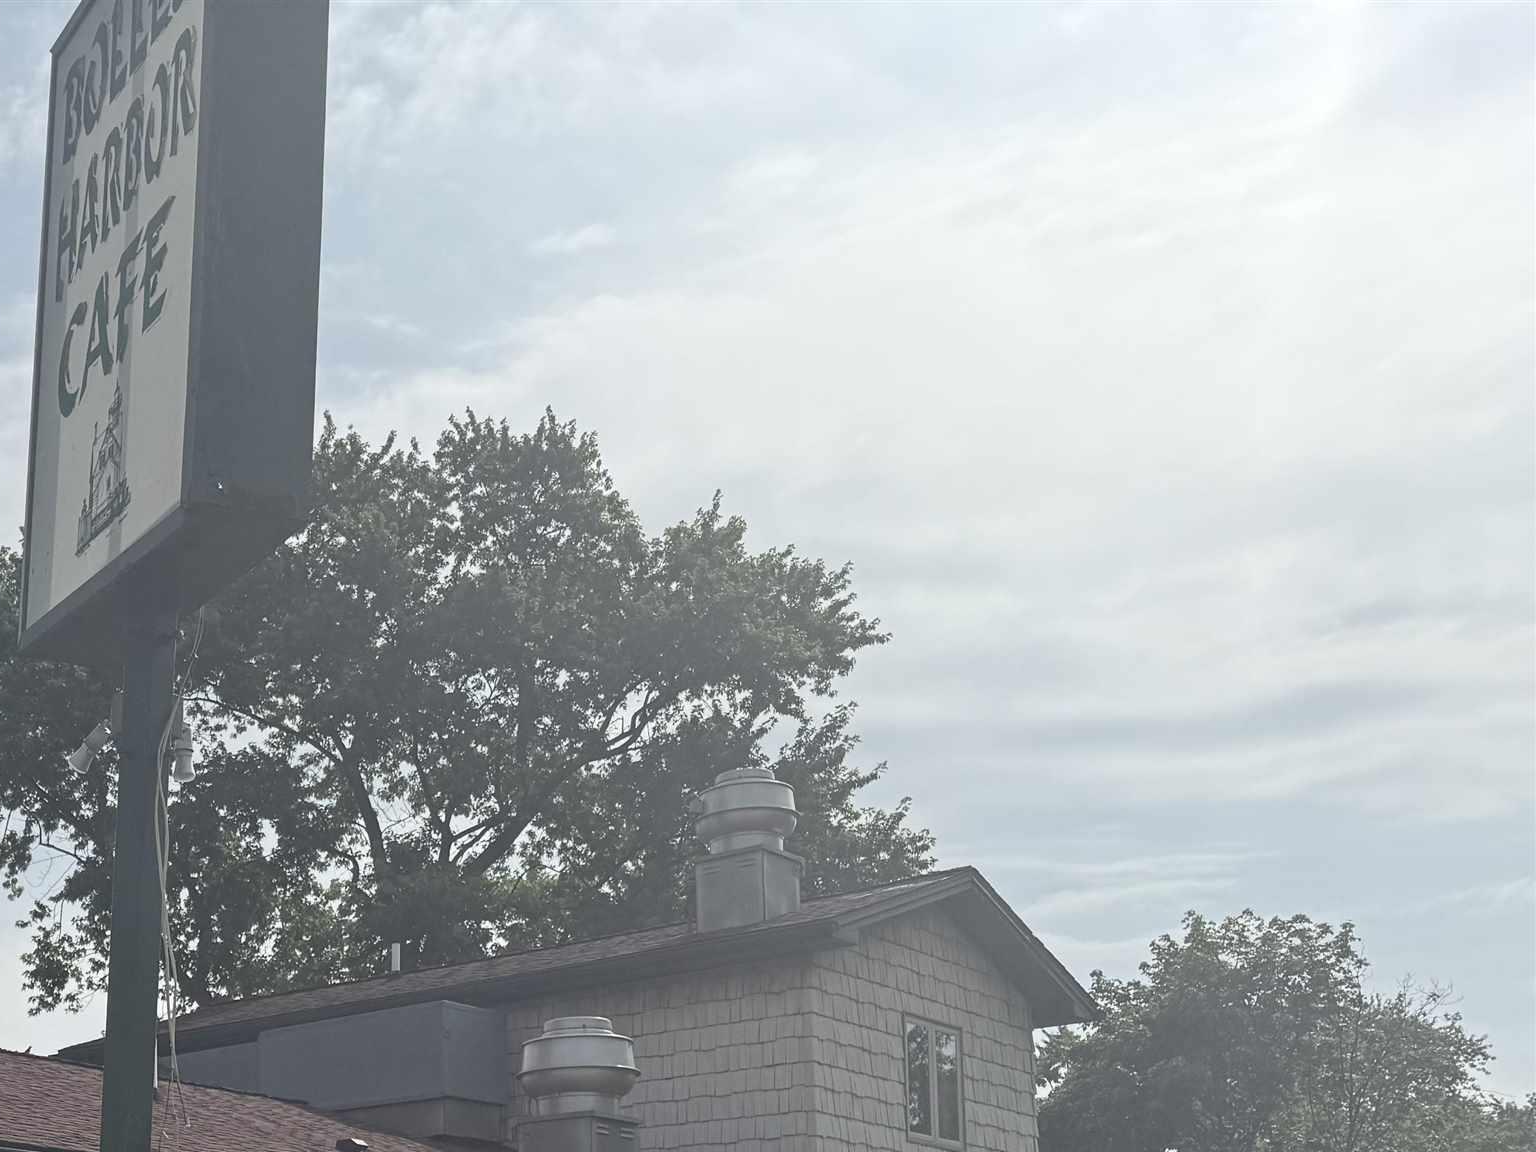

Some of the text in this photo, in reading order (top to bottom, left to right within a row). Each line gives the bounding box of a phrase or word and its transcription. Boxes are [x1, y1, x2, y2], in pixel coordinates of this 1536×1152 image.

[57, 25, 197, 303] HARBOR
[62, 0, 183, 165] BOLL
[59, 195, 176, 418] CAFE
